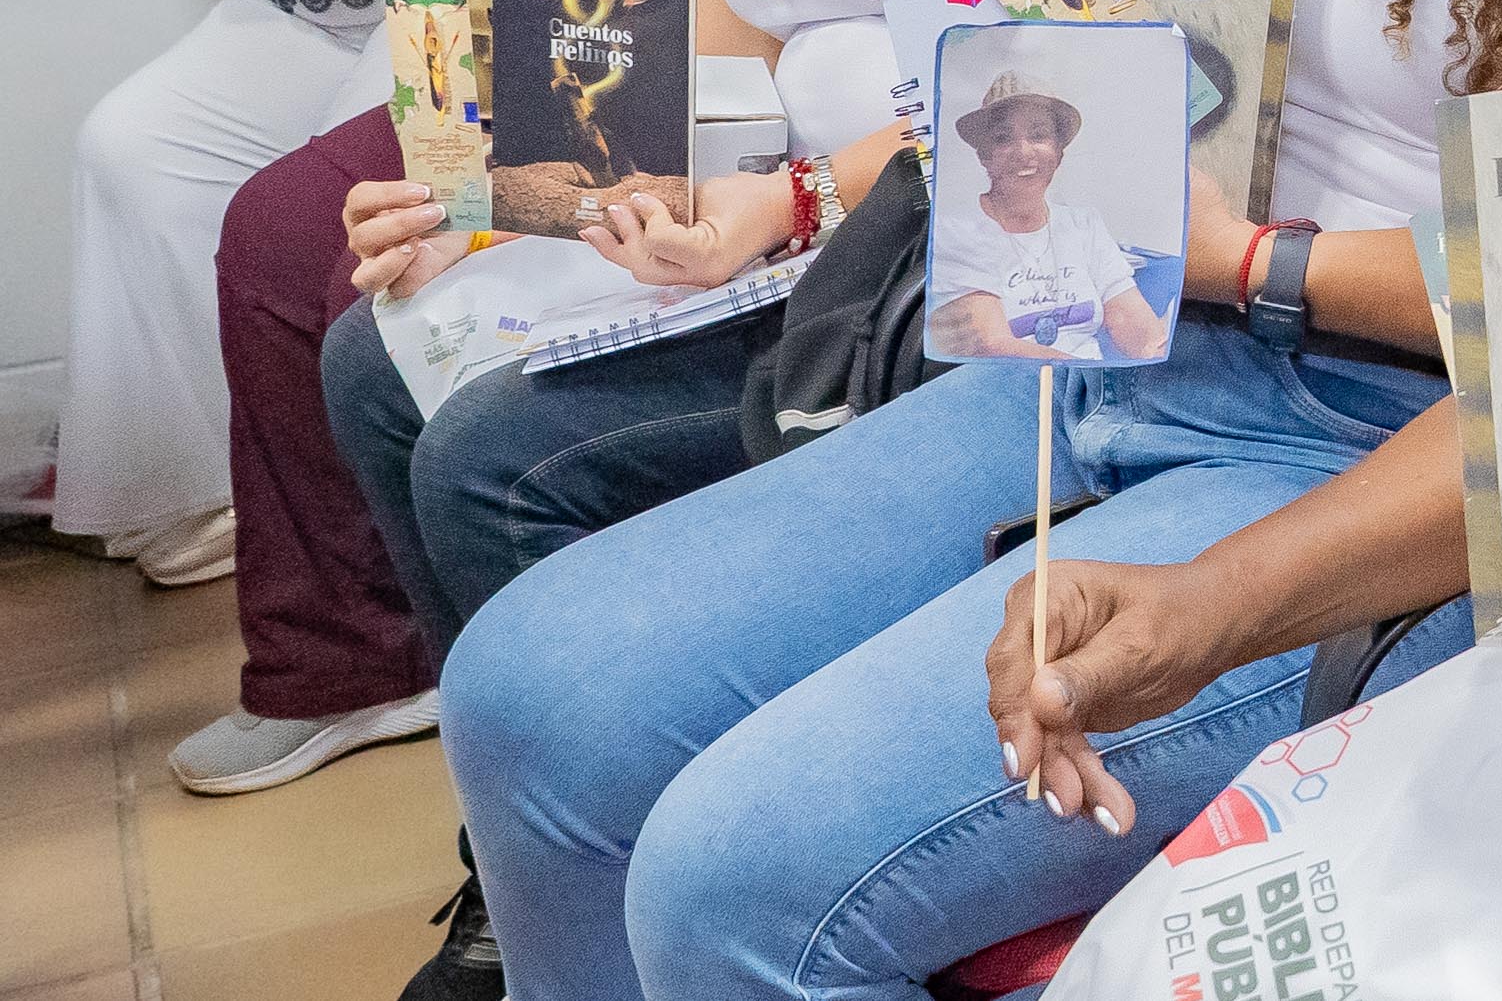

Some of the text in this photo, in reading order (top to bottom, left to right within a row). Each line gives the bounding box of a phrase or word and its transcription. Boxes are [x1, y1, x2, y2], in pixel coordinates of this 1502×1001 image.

[549, 38, 635, 69] Felinos
[550, 18, 635, 45] Cuentos
[1164, 912, 1196, 970] DEL
[1201, 893, 1264, 1001] PÚB
[1307, 859, 1359, 1001] RED DEPA
